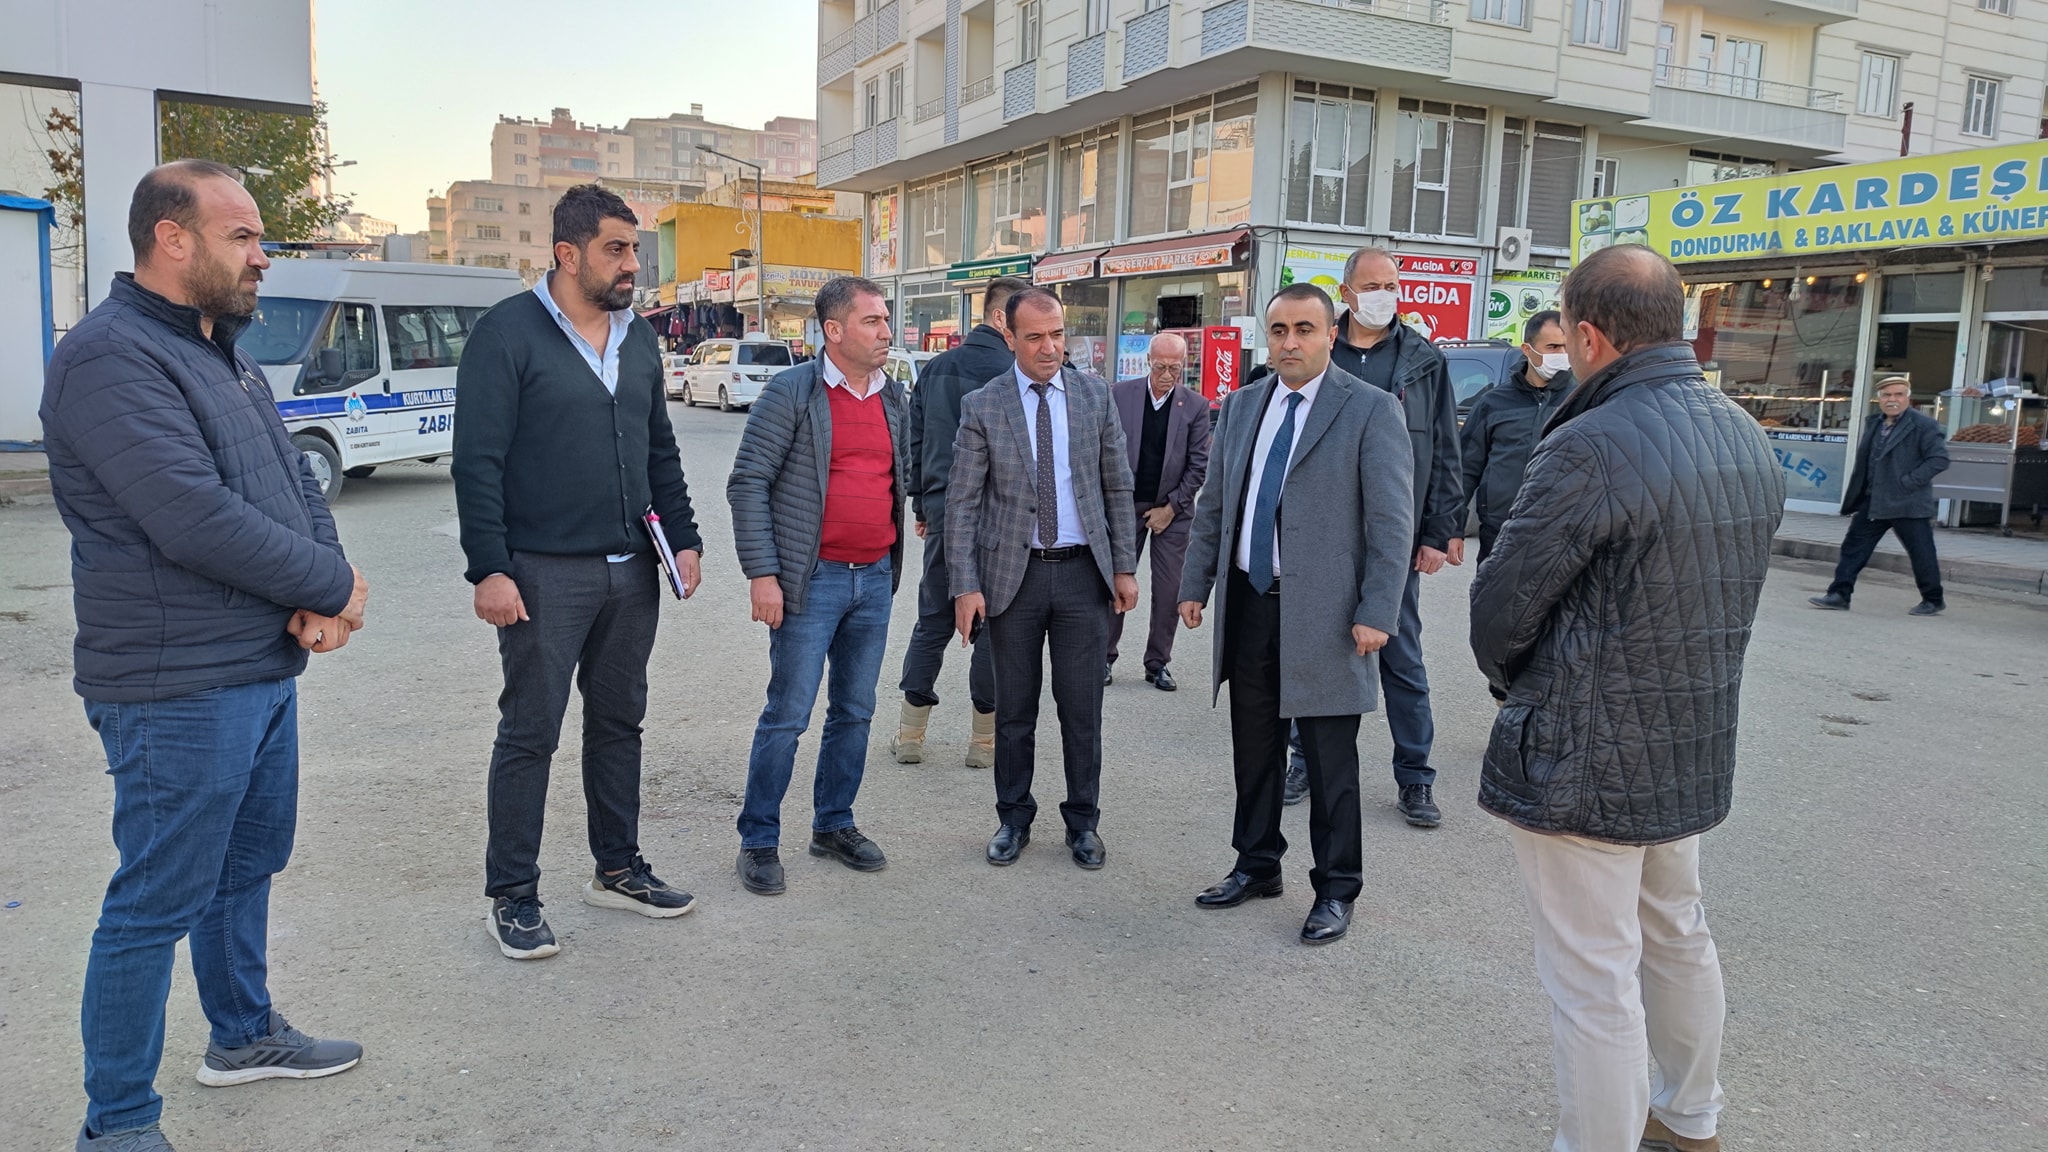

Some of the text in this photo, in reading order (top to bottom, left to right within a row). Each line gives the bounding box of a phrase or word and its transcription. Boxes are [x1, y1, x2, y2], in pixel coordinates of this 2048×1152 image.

[1671, 191, 1743, 228] ÖZ
[1670, 230, 1782, 257] DONDURMA
[1794, 228, 1808, 248] &
[1815, 217, 1930, 246] BAKLAVA
[1938, 214, 1954, 236] &
[1125, 252, 1200, 269] SERHAT MARKET
[1411, 260, 1444, 272] ALGİDA
[1520, 270, 1556, 280] MARKET
[402, 390, 442, 406] KURTALAN
[346, 426, 368, 435] ZABITA
[418, 414, 454, 436] ZABI
